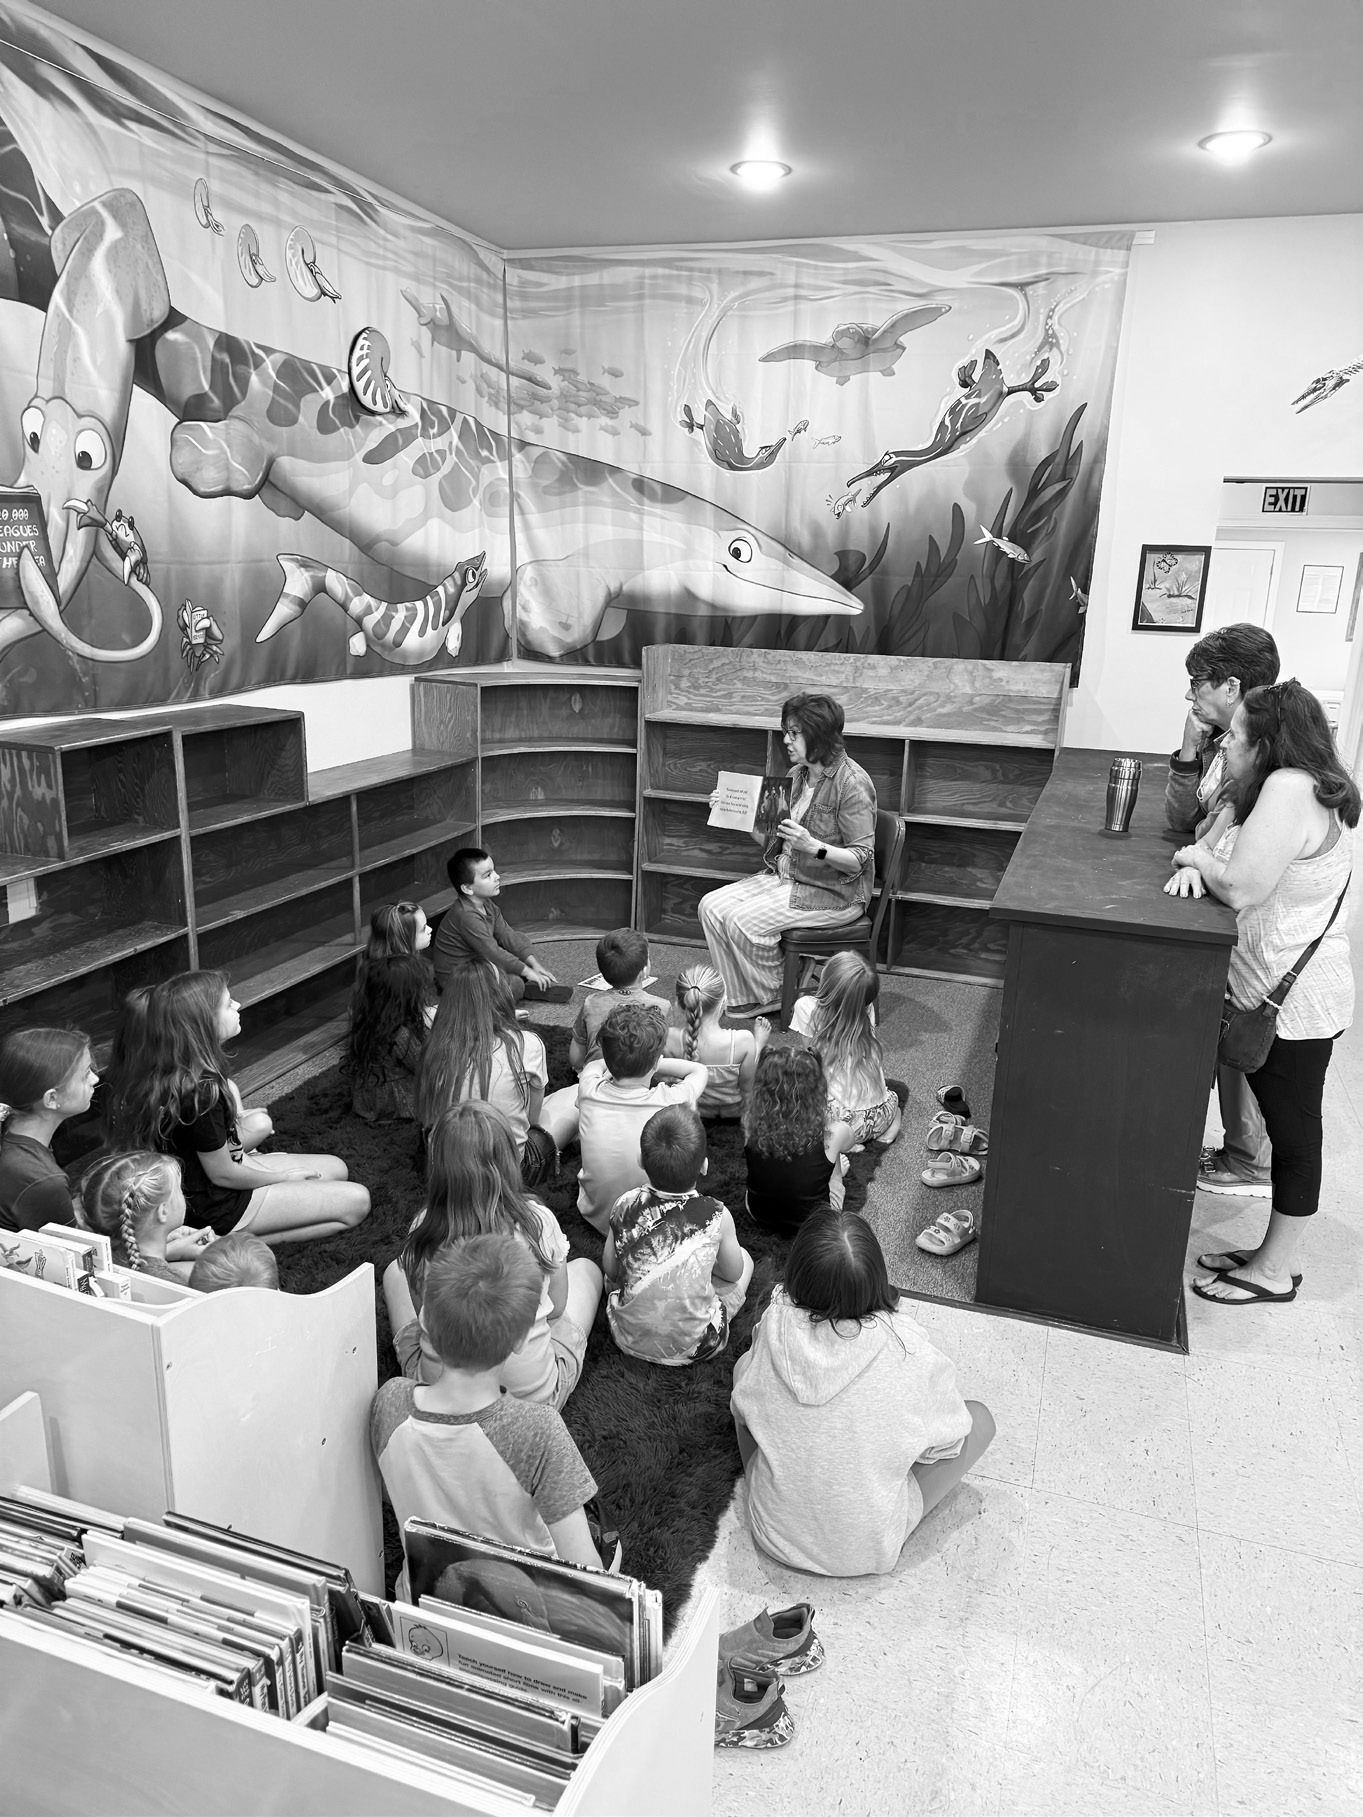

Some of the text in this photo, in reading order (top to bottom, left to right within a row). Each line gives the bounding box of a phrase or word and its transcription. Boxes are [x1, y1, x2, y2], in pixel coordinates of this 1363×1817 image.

[1263, 488, 1306, 512] EXIT
[0, 508, 29, 522] 0,000
[0, 540, 37, 553] UNDR
[457, 1653, 478, 1664] Teach
[479, 1662, 506, 1674] yourself
[507, 1670, 522, 1679] how
[533, 1679, 551, 1688] draw
[552, 1685, 567, 1693] and
[567, 1690, 587, 1700] make
[540, 1687, 556, 1695] with
[557, 1692, 571, 1700] this
